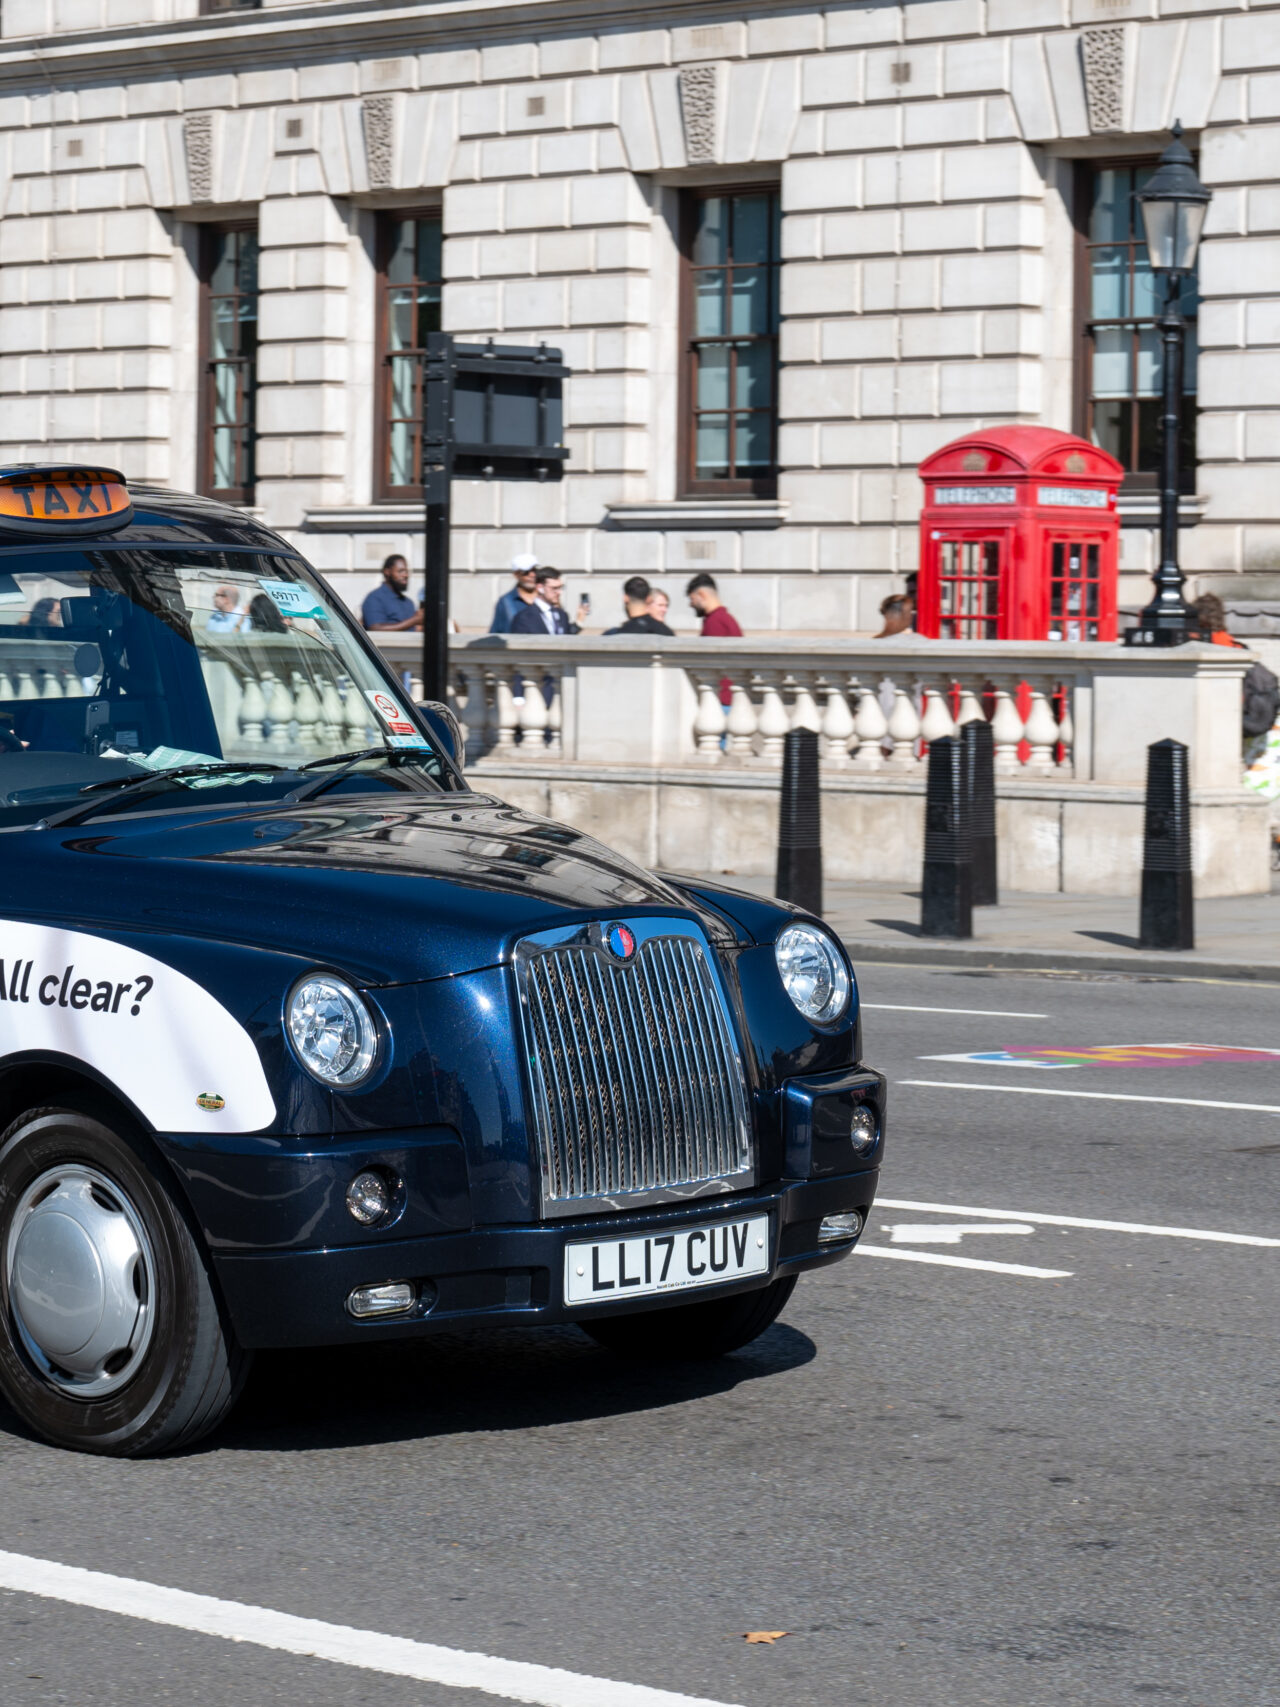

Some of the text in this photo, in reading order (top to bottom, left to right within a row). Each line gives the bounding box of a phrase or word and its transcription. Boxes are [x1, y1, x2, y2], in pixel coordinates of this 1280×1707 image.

[11, 482, 112, 516] TAXI
[271, 591, 300, 602] 69777
[38, 965, 154, 1017] clear?
[591, 1222, 749, 1292] LL17 CUV
